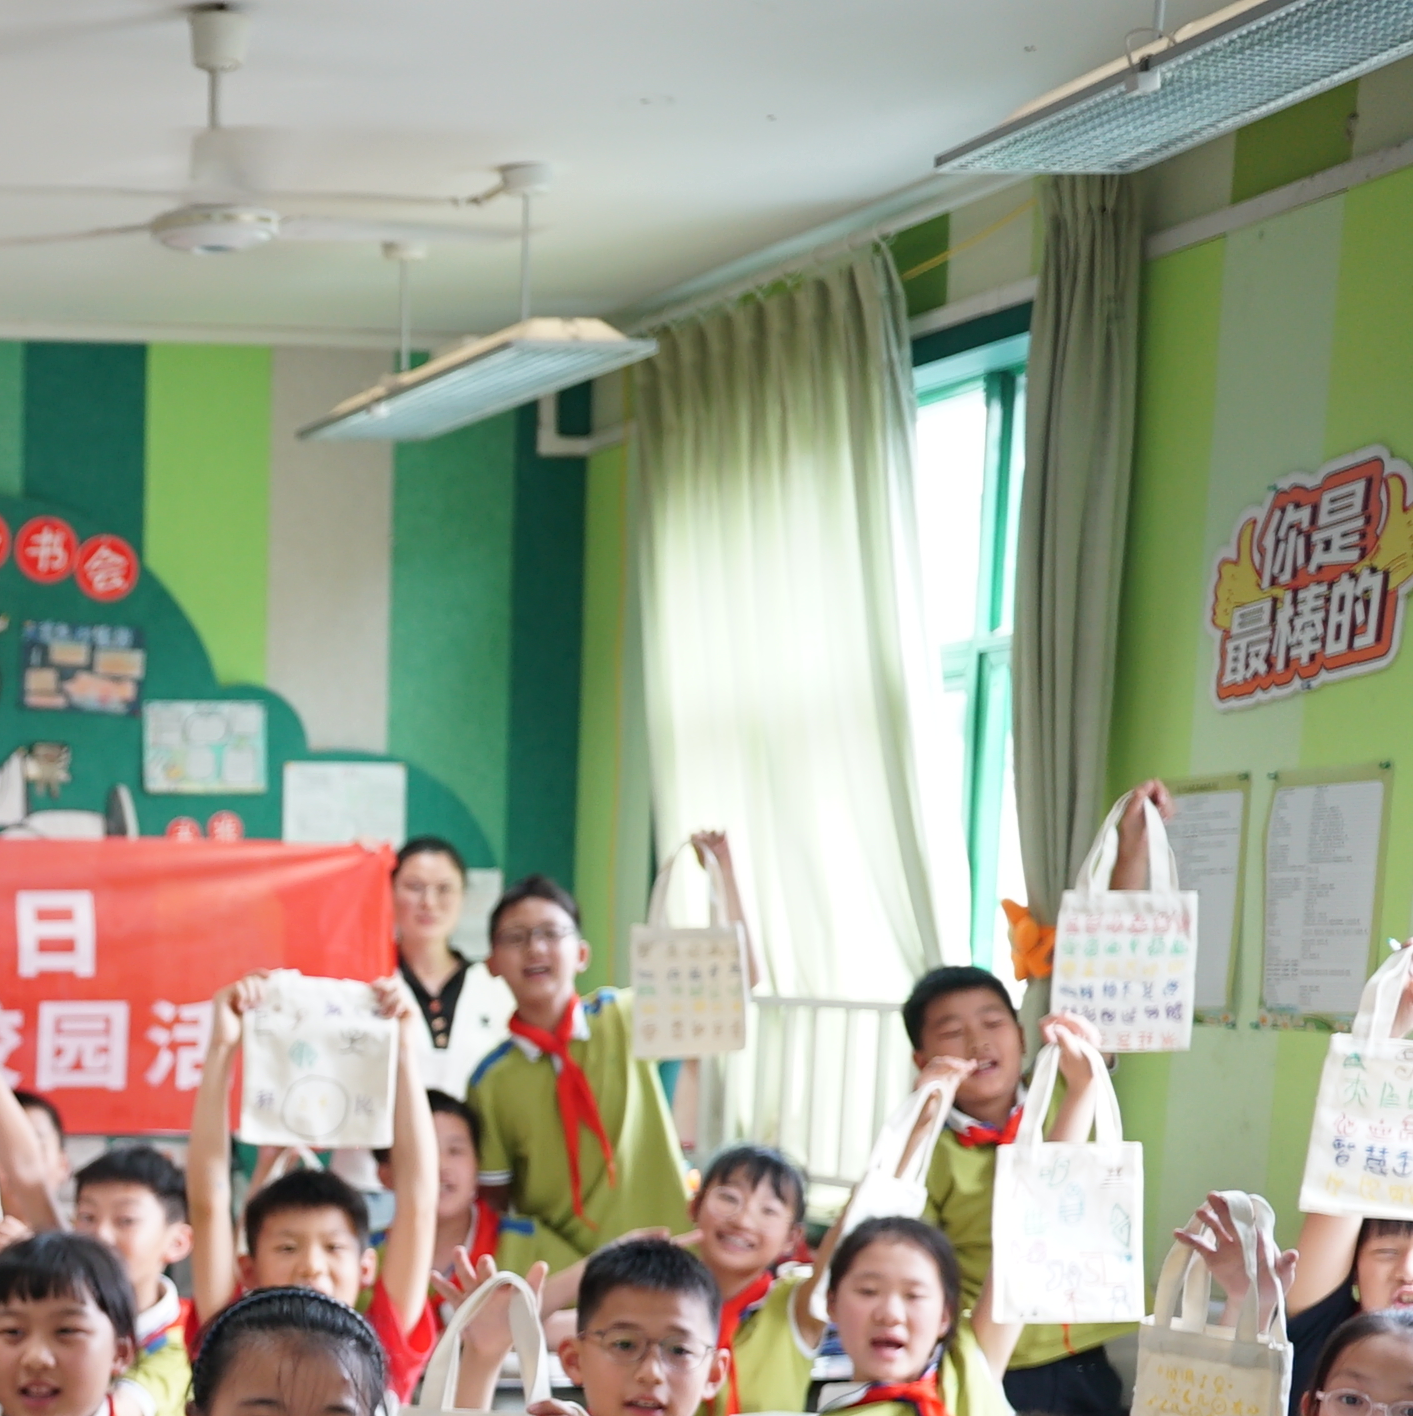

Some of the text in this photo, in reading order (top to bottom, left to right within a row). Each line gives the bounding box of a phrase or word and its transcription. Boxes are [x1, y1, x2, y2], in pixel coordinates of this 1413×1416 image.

[1260, 476, 1372, 590] 你是
[1223, 565, 1384, 685] 最棒的
